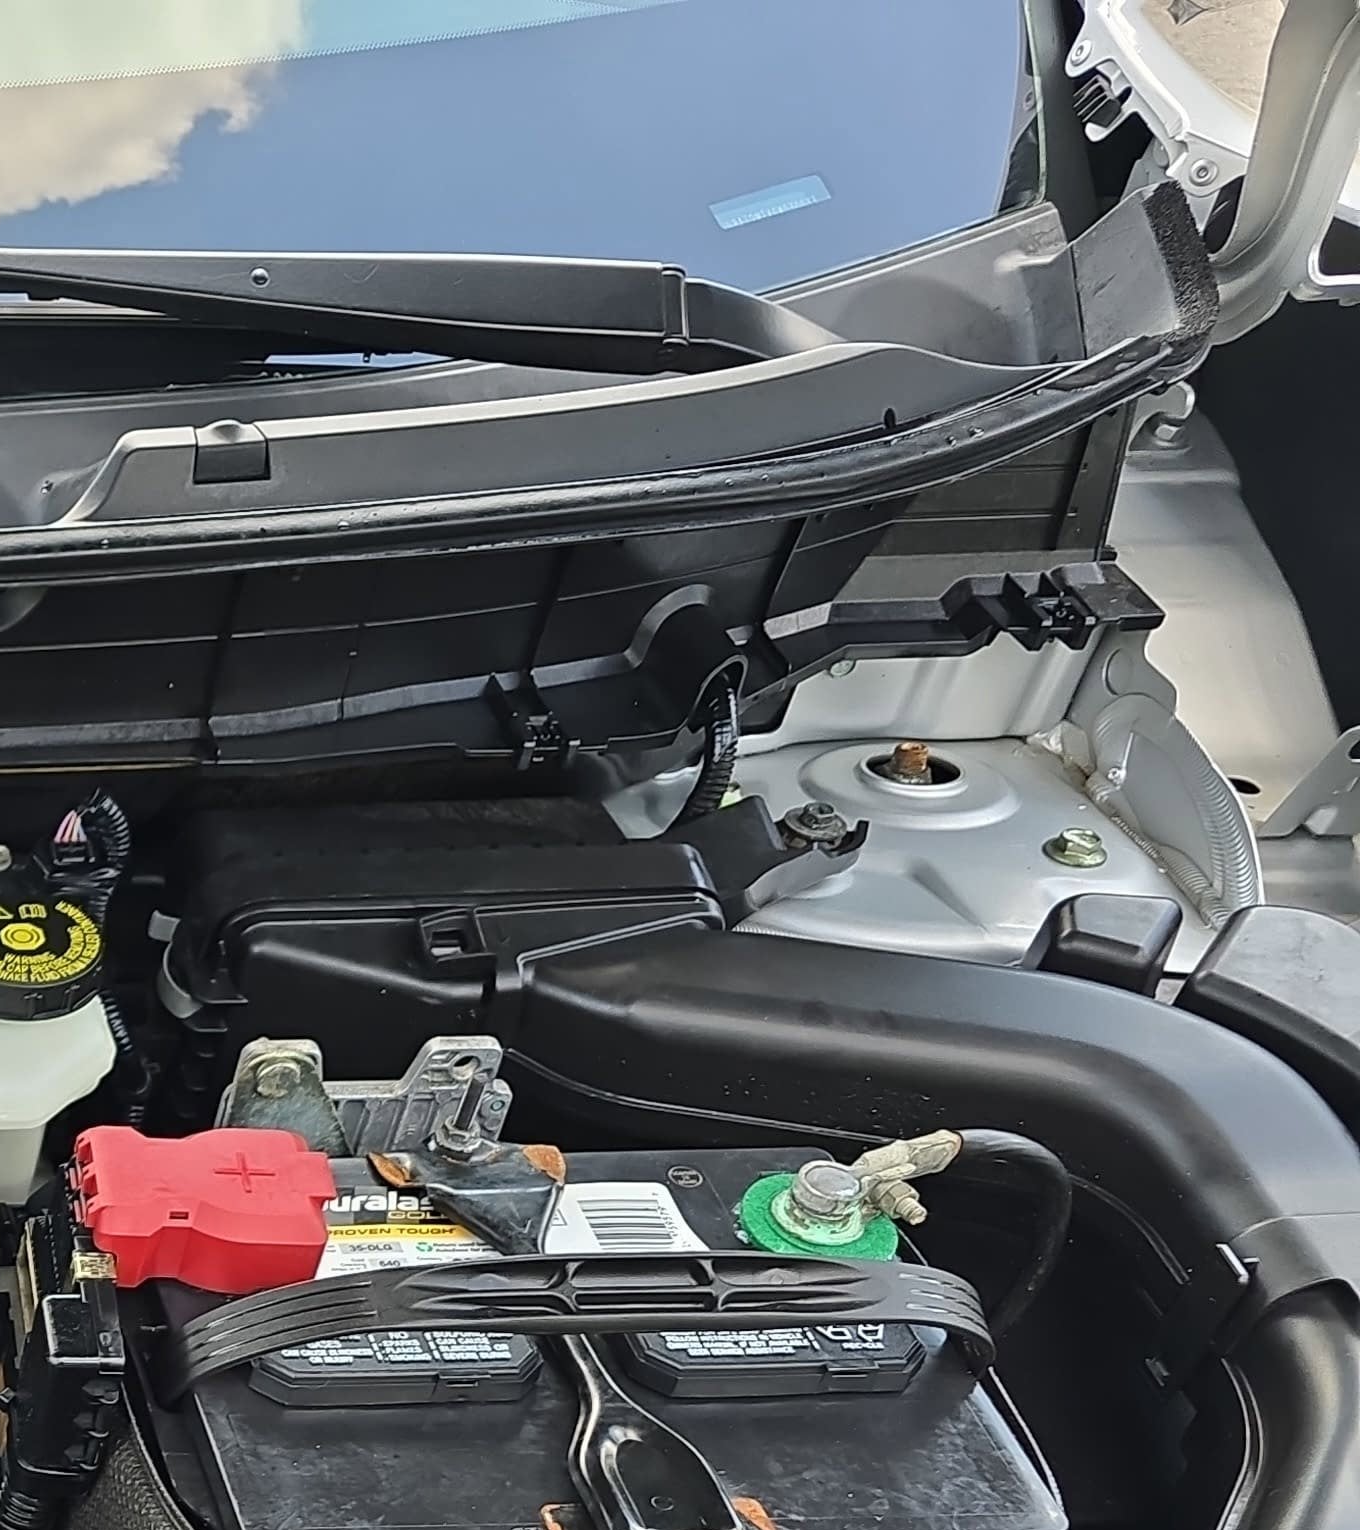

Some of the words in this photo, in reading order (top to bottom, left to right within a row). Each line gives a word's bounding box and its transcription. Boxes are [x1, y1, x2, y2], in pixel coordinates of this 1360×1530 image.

[322, 1191, 435, 1213] uralas
[387, 1210, 449, 1220] GOL
[396, 1226, 456, 1236] TOUGH
